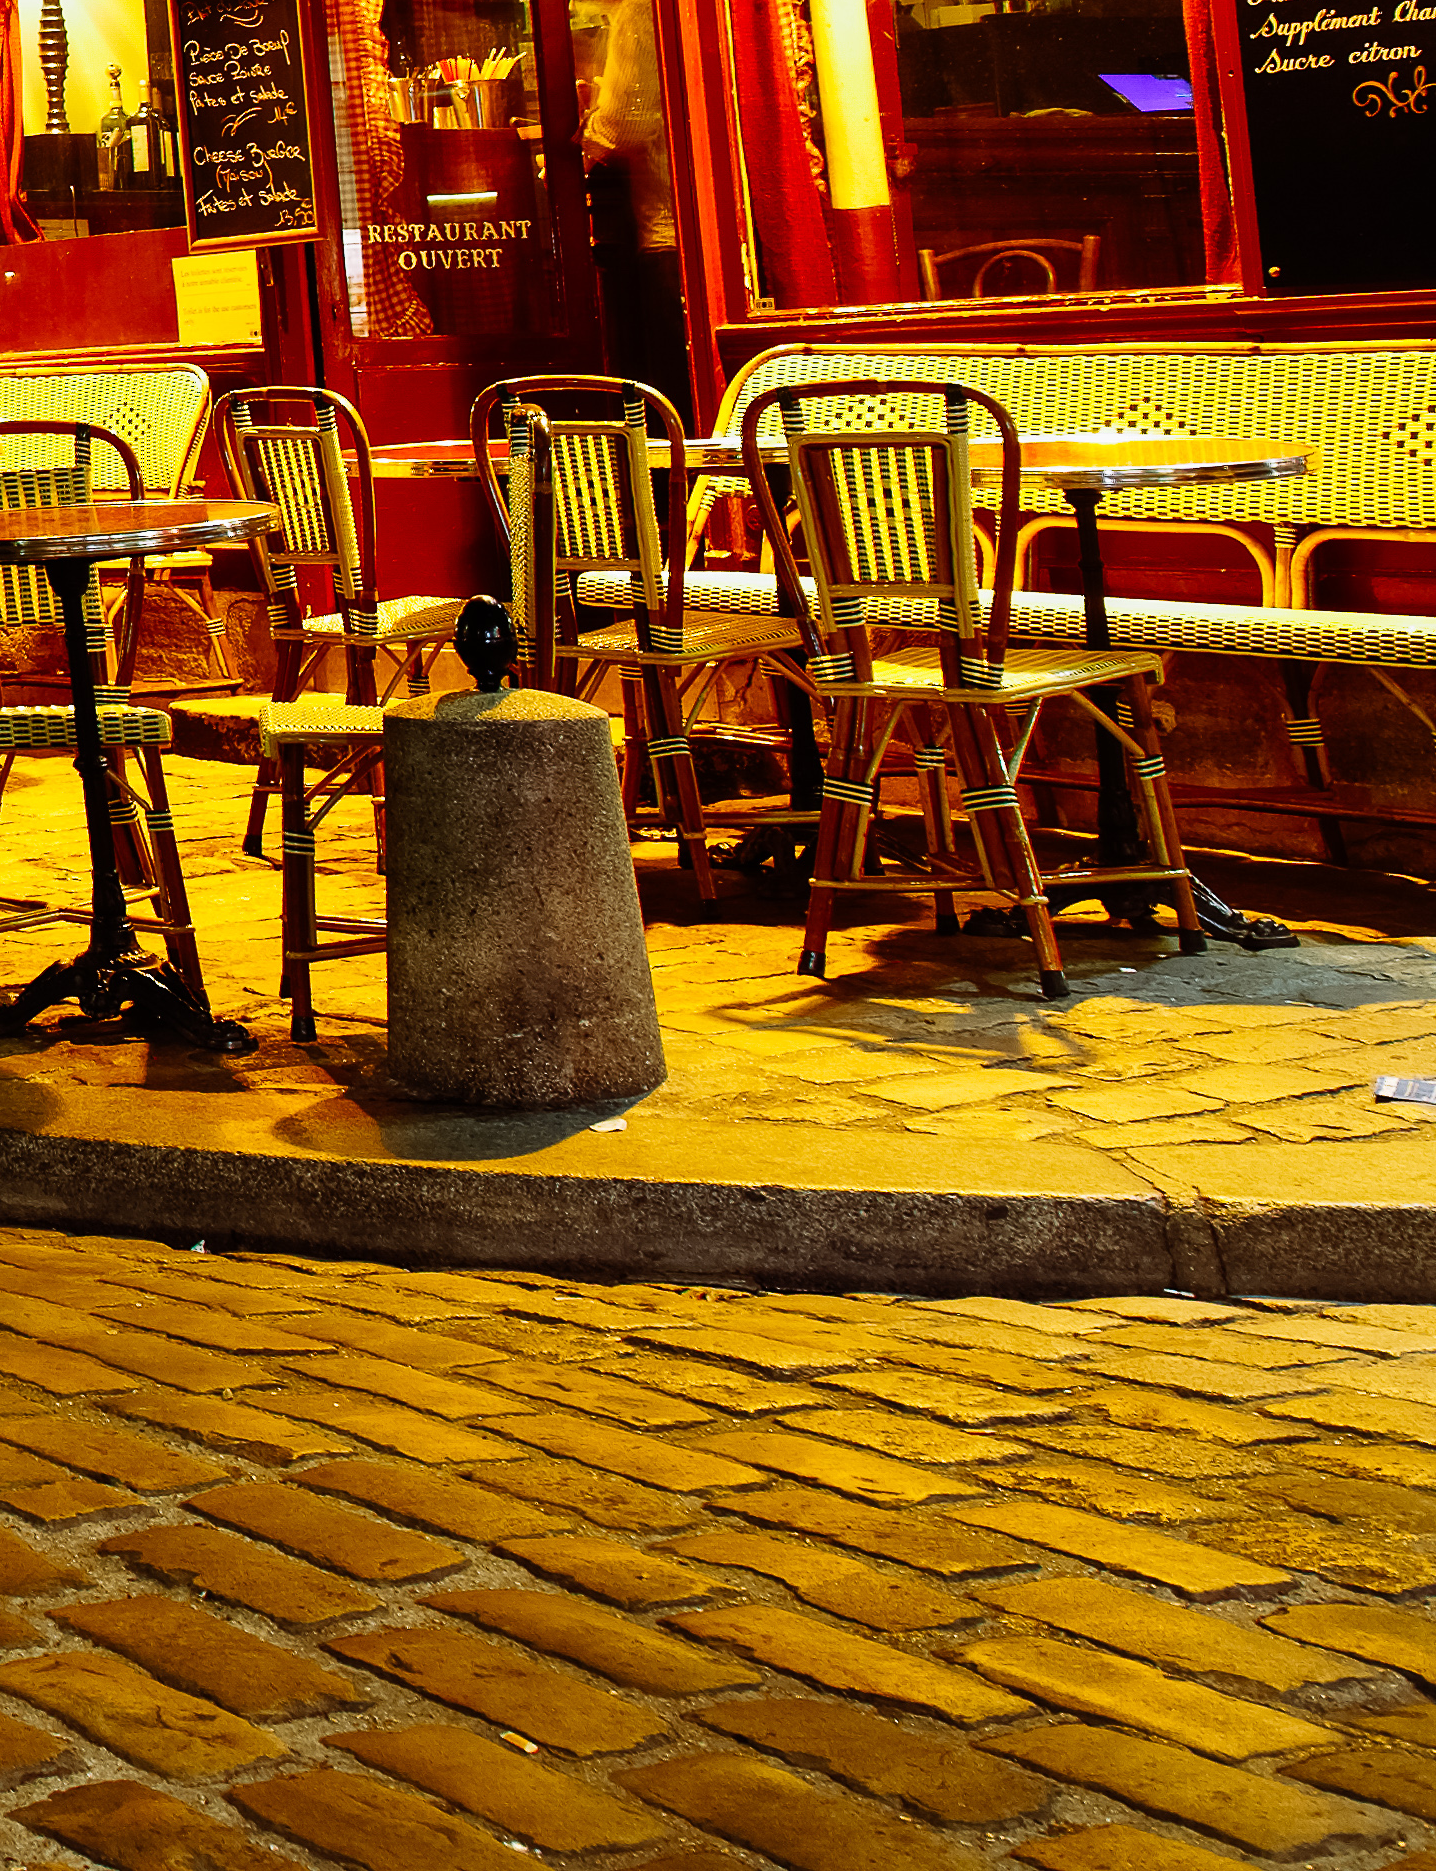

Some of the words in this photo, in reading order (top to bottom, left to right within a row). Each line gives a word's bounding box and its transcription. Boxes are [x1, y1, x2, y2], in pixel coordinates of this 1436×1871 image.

[1250, 6, 1383, 46] Supplément
[1254, 49, 1335, 74] Sucre
[1348, 42, 1422, 64] citron
[230, 86, 245, 105] et
[238, 187, 254, 207] et
[367, 219, 532, 244] RESTAURANT
[398, 248, 503, 271] OUVERT
